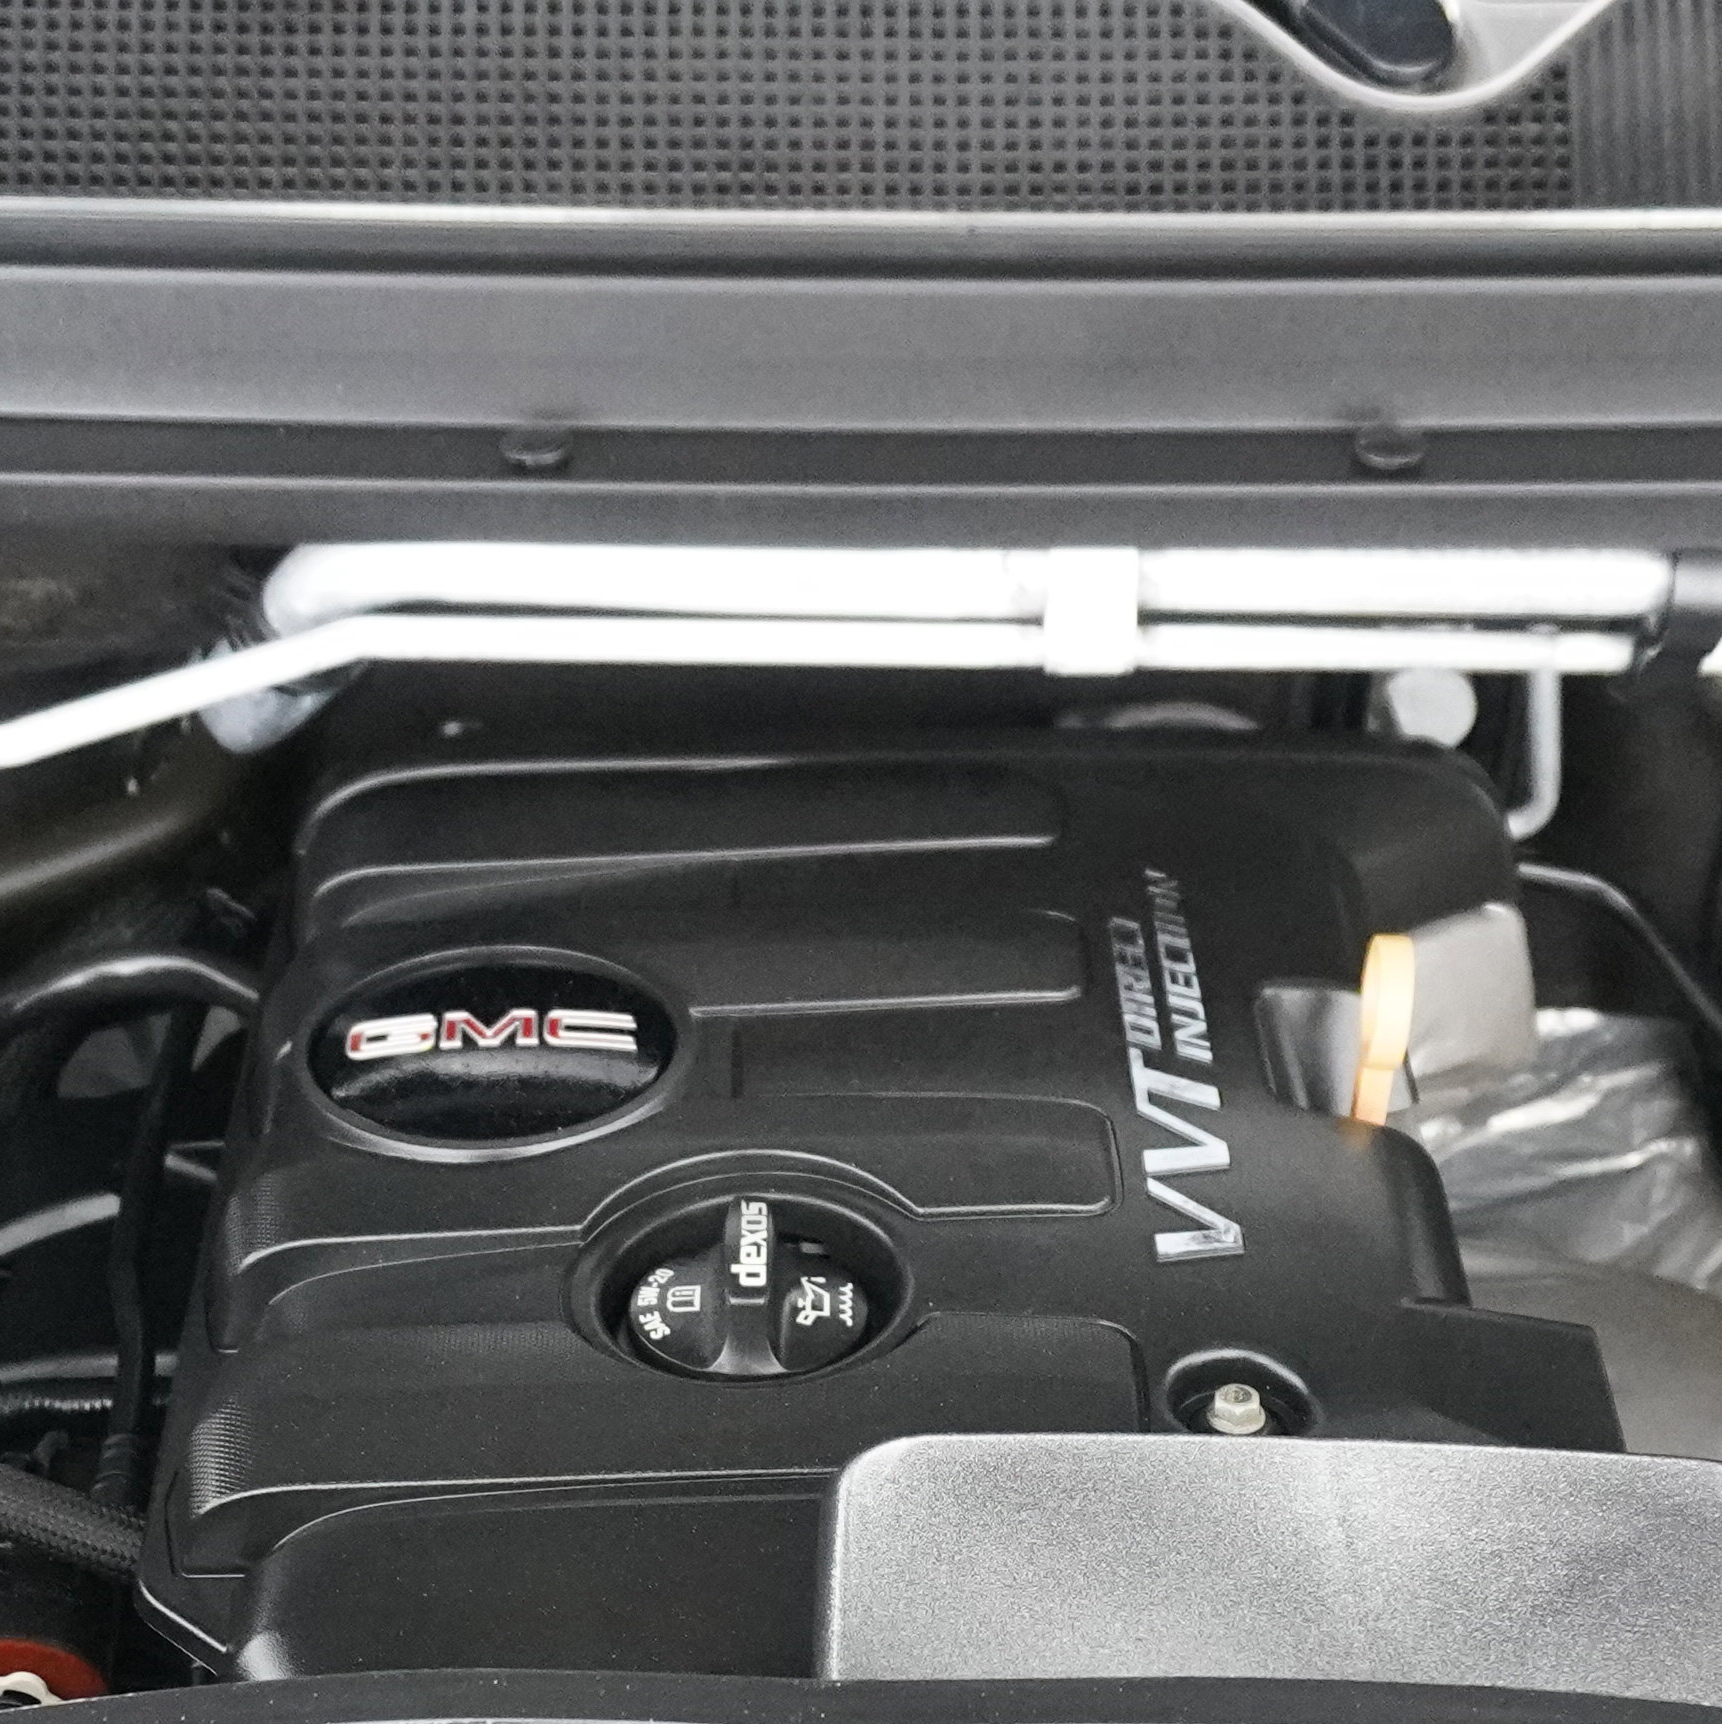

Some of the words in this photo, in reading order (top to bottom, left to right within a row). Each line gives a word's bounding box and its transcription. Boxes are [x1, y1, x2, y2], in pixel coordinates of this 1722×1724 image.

[345, 1008, 638, 1061] GMC
[1128, 1047, 1245, 1262] VVT
[729, 1200, 768, 1287] dexos
[637, 1267, 675, 1307] 5W-20
[638, 1310, 671, 1340] SAE
